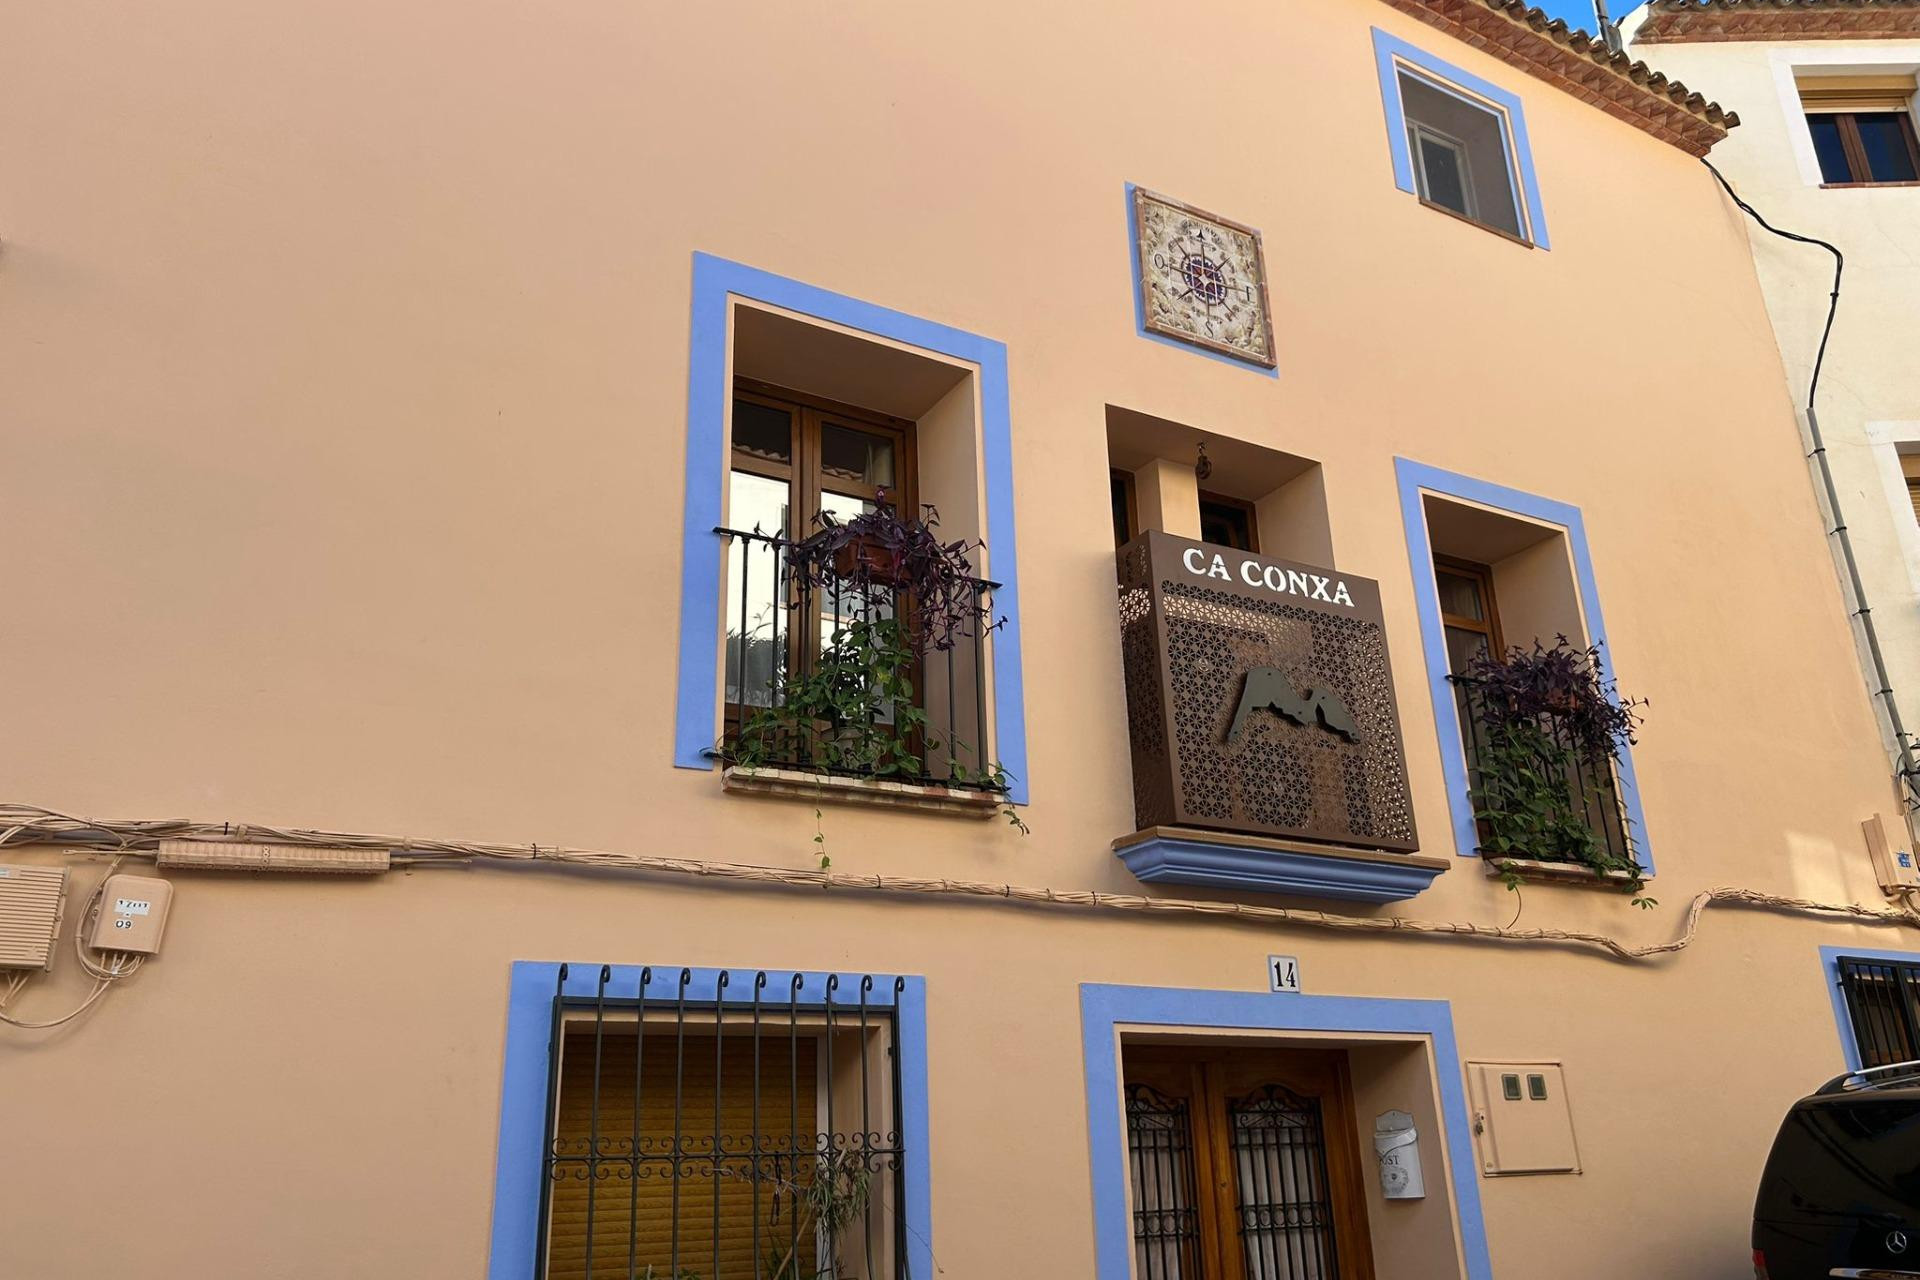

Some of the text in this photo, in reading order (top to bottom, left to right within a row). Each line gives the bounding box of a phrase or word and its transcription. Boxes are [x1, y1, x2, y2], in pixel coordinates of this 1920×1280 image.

[1182, 548, 1355, 608] CA CONXA
[1274, 960, 1296, 988] 14
